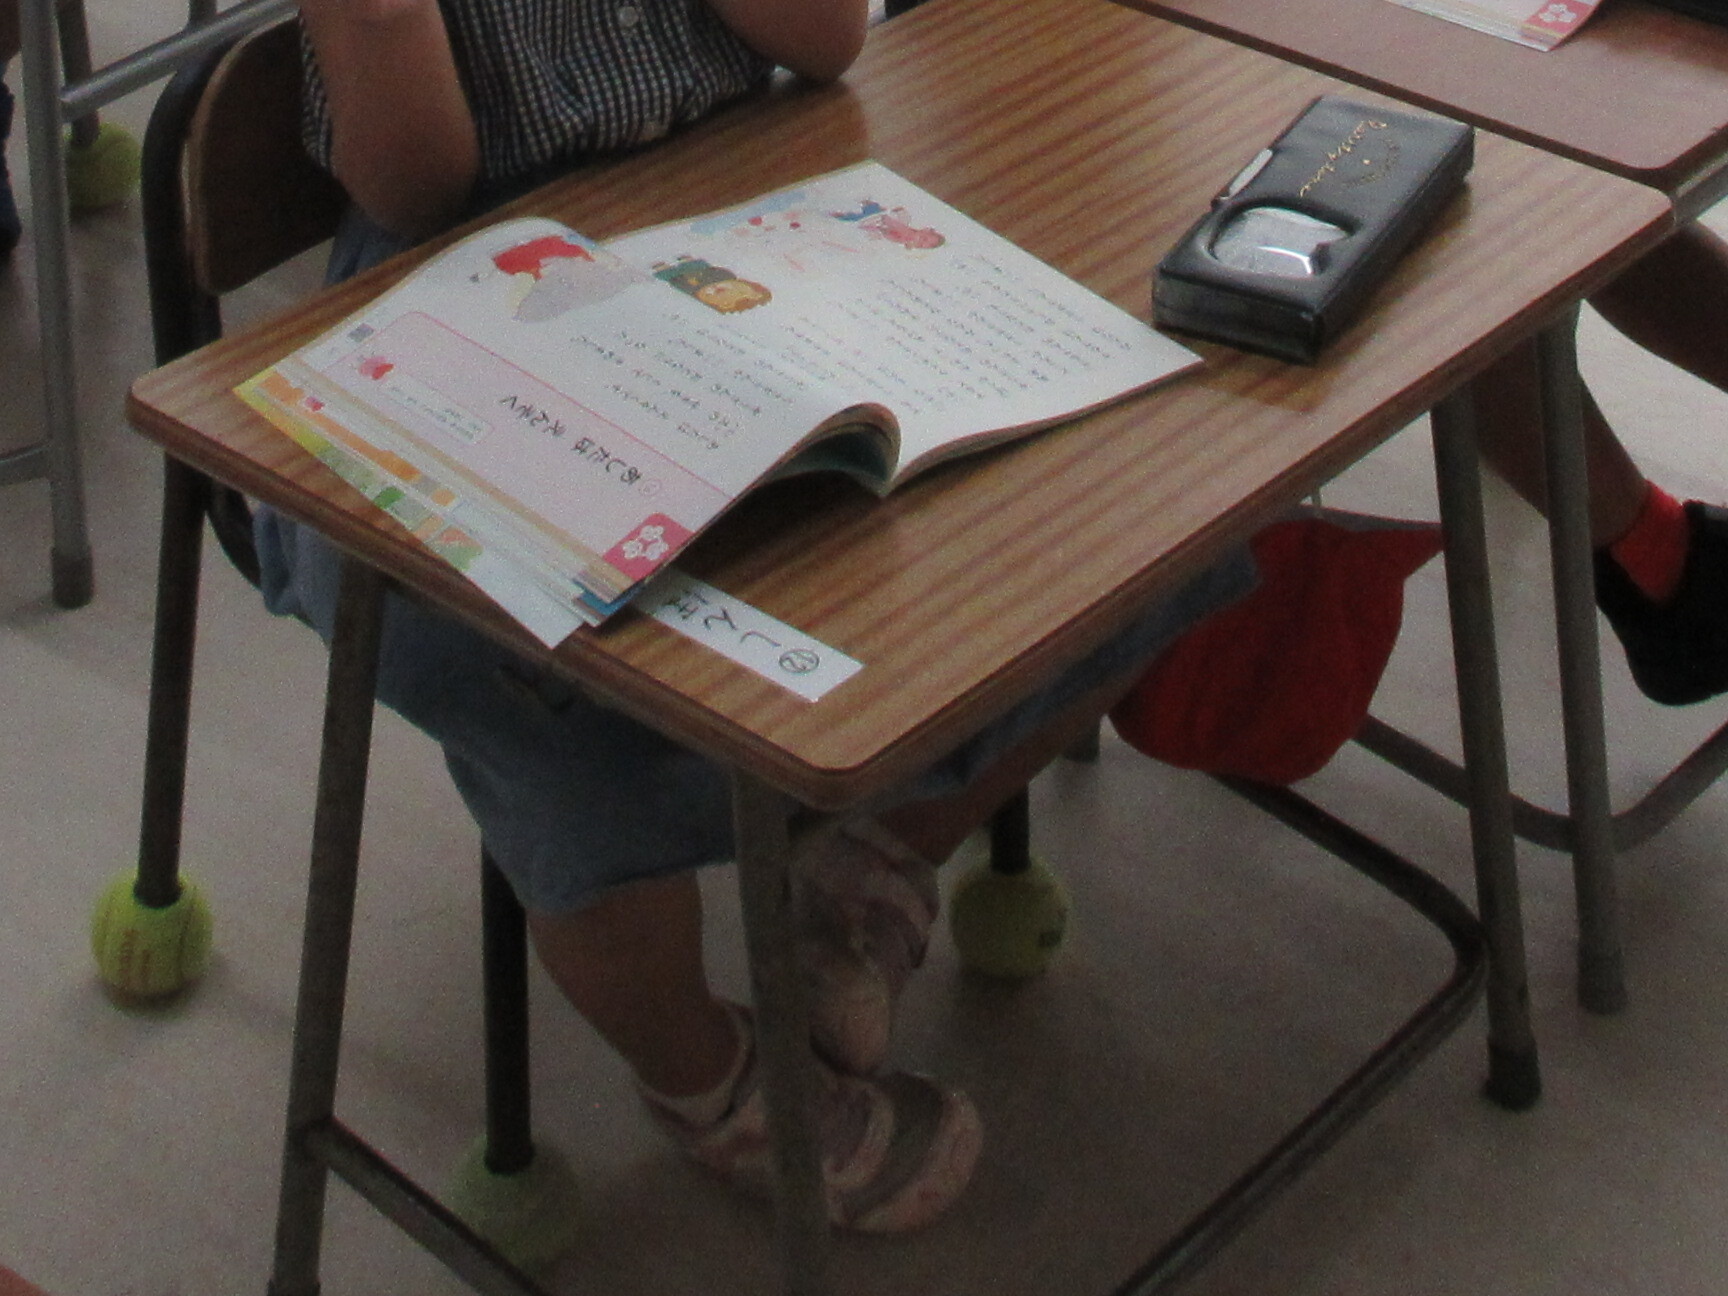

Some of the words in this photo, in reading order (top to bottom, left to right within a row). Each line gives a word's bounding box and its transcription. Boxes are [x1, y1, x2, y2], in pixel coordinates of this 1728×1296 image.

[499, 394, 568, 438] えんそく
[570, 436, 643, 486] あしたは
